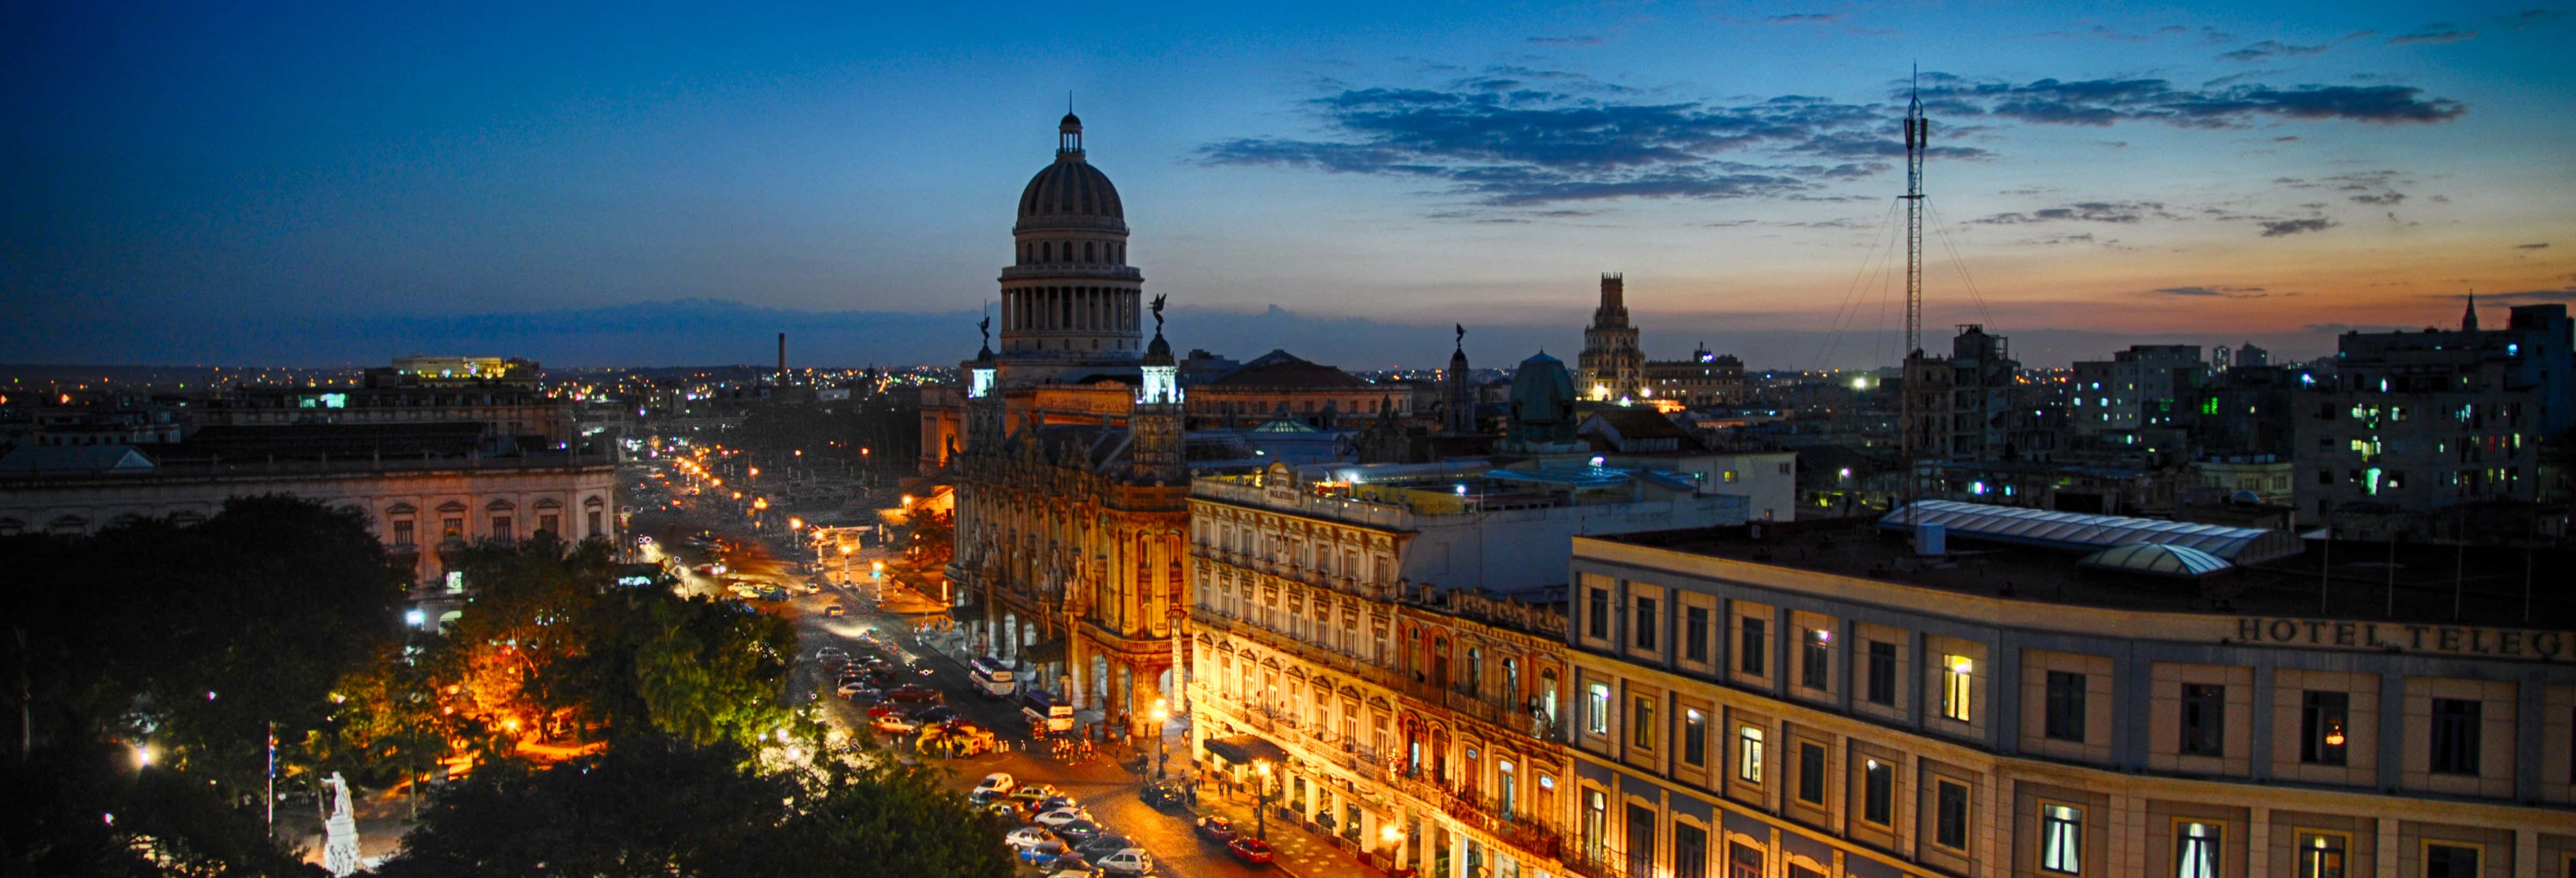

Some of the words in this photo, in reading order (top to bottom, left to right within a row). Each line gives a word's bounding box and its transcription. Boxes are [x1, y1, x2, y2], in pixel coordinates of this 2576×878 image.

[1269, 489, 1295, 501] INGLATERRA
[2237, 618, 2384, 648] HOTEL
[2405, 624, 2576, 657] TELEG
[1172, 618, 1183, 711] INGLATERRA
